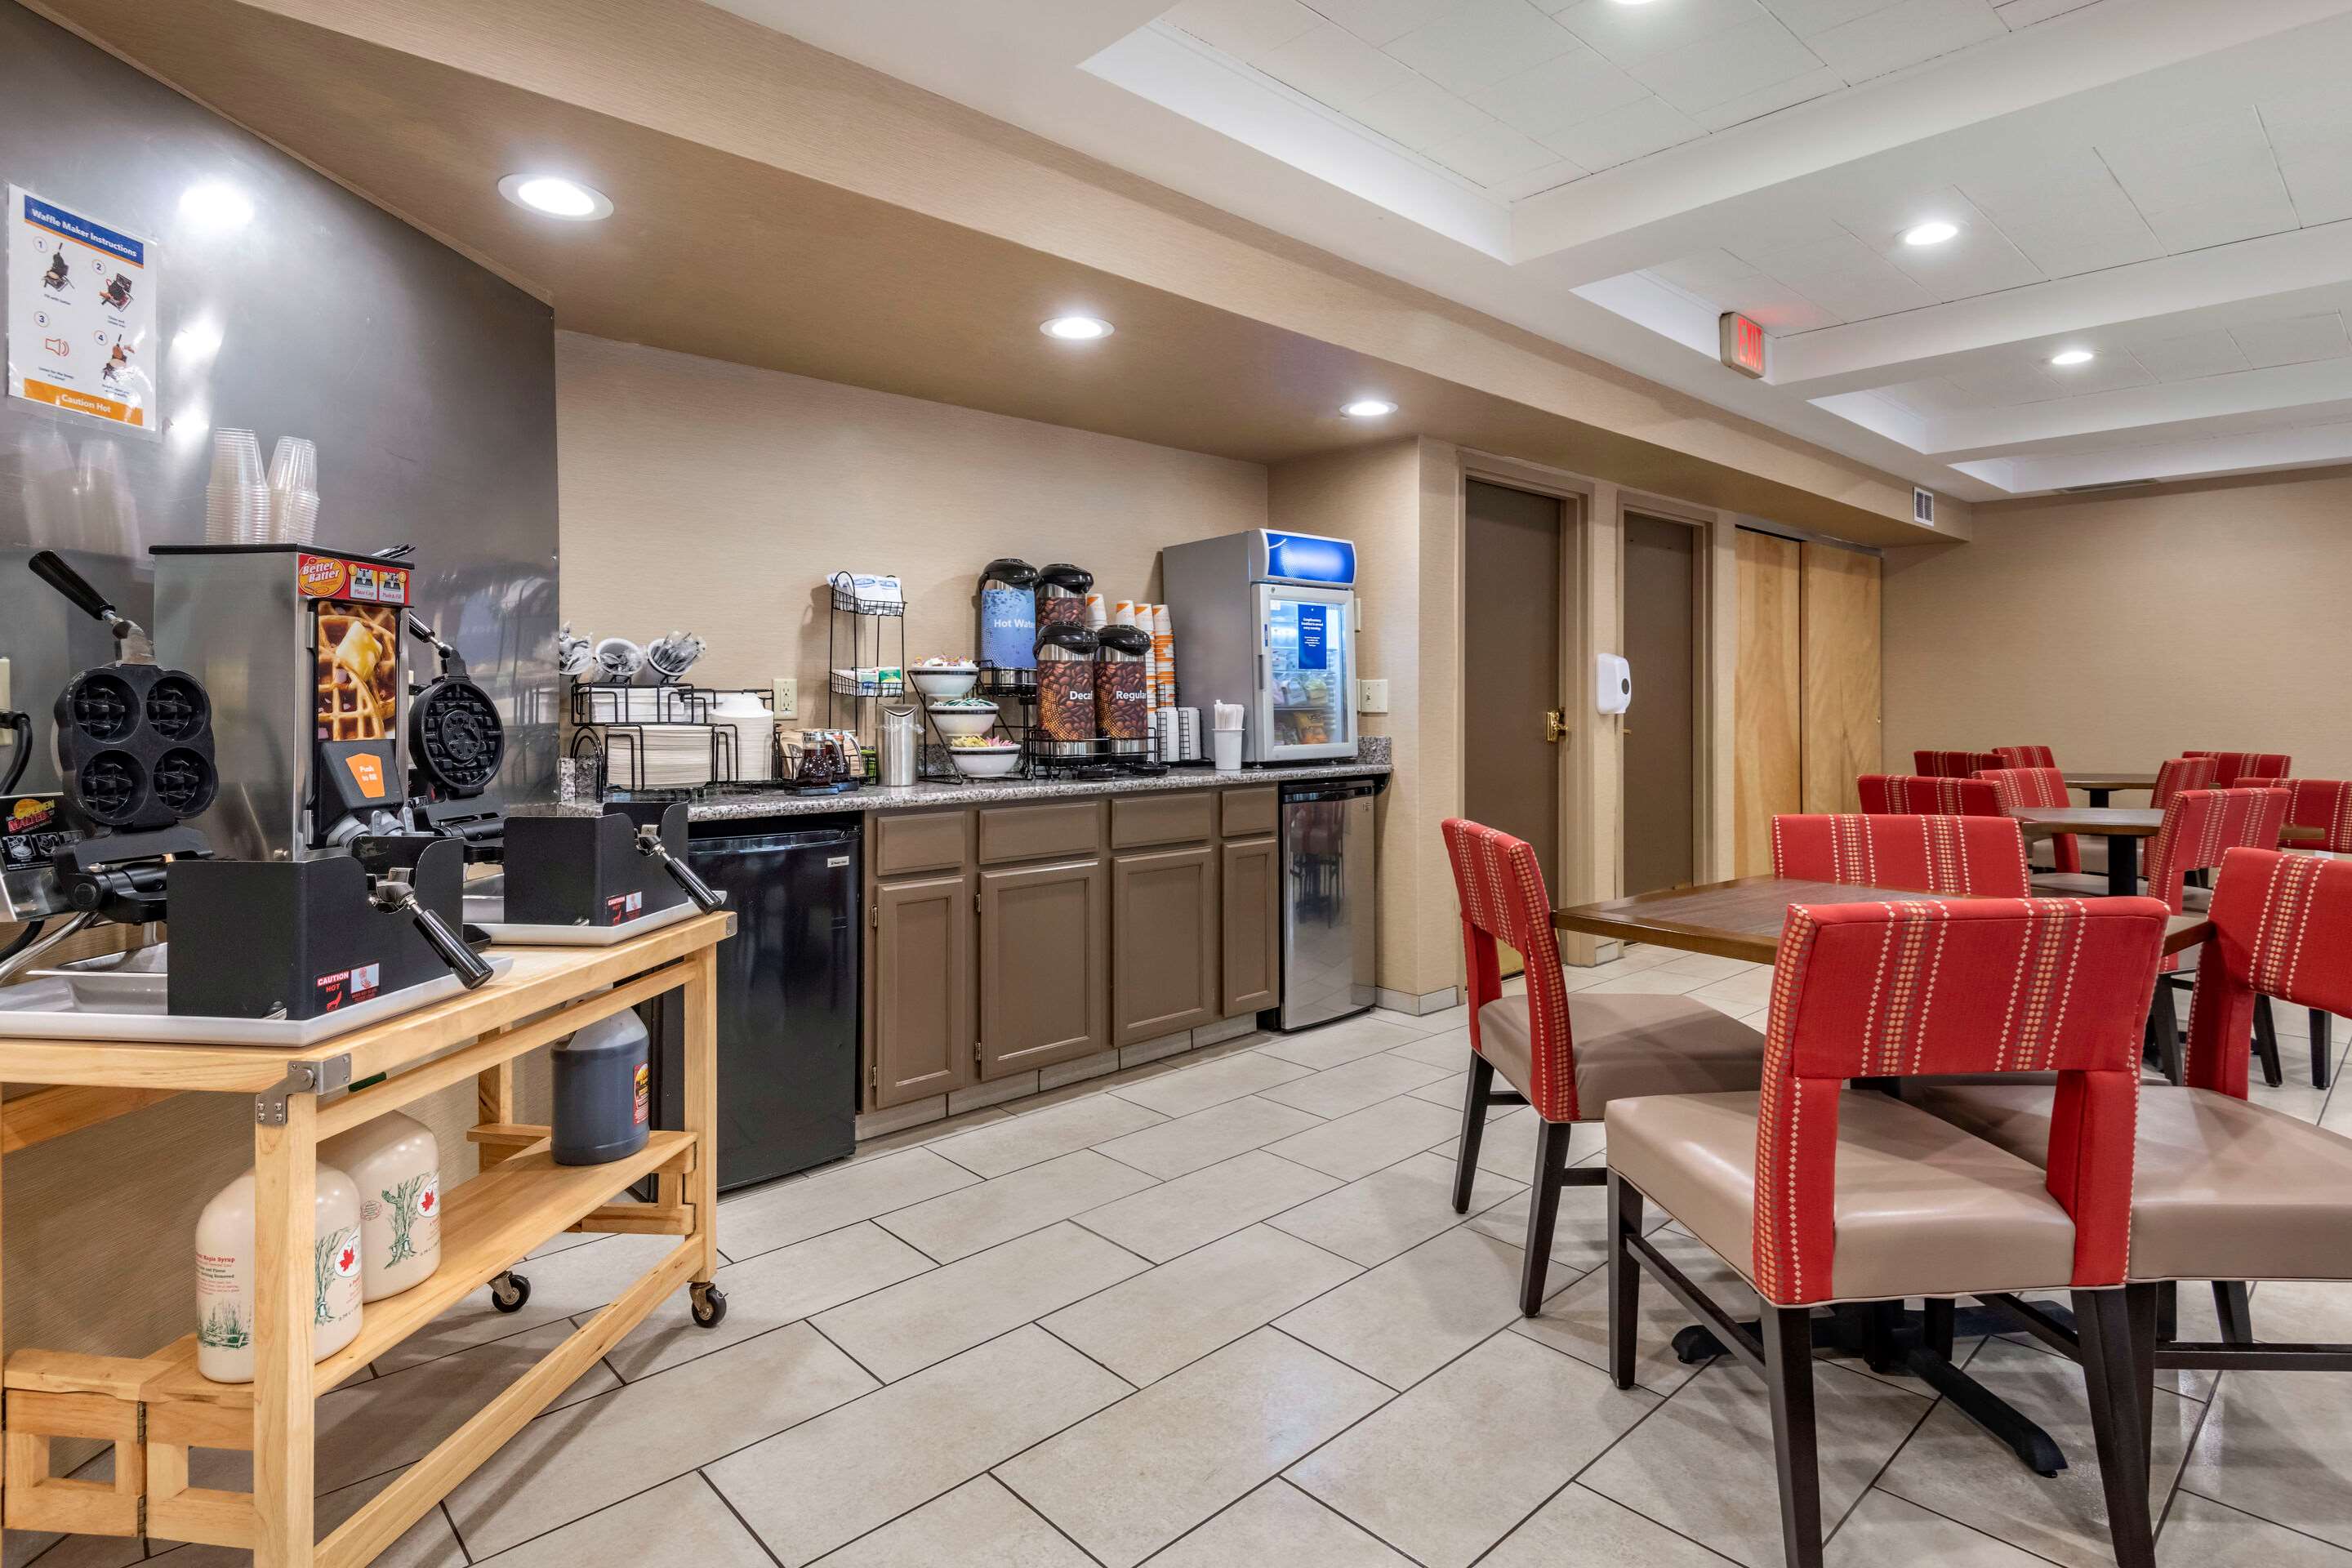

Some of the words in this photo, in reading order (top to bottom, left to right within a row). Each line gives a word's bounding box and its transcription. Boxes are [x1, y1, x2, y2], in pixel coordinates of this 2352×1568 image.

[32, 208, 61, 227] Waffle
[62, 221, 89, 238] Maker
[91, 233, 137, 257] Instructions
[96, 263, 102, 271] 2
[38, 314, 45, 323] 3
[98, 333, 105, 342] 4
[1738, 317, 1763, 372] EXIT
[61, 394, 95, 408] Caution
[96, 403, 111, 413] Hot
[302, 561, 334, 575] Better
[308, 569, 340, 583] Batter
[994, 618, 1011, 628] Hot
[1069, 690, 1093, 700] Decaf
[1116, 690, 1147, 702] Regular
[318, 970, 350, 987] CAUTION
[326, 983, 341, 992] HOT
